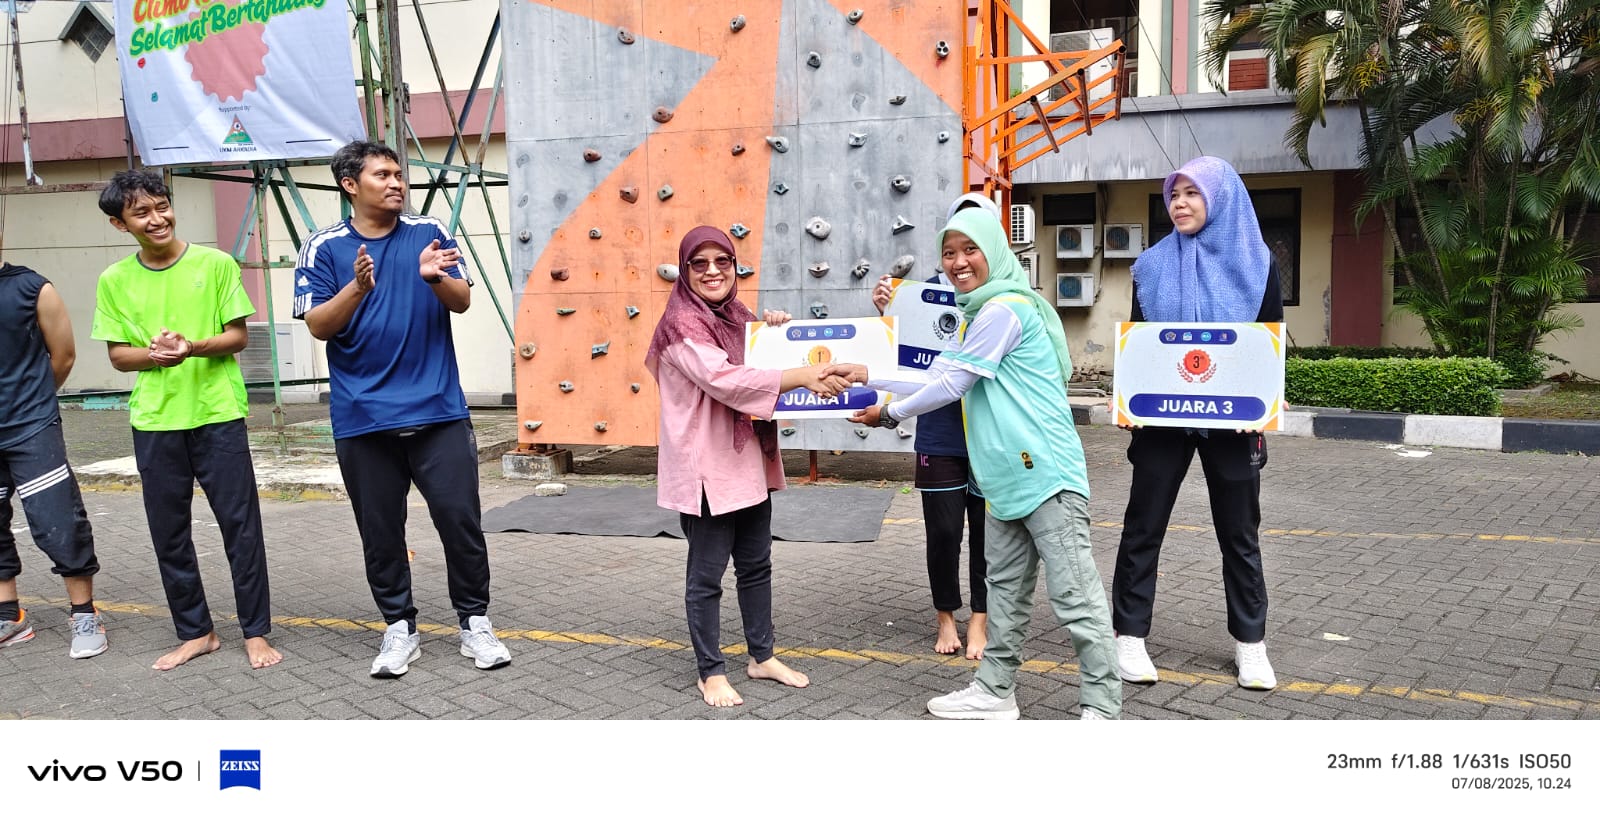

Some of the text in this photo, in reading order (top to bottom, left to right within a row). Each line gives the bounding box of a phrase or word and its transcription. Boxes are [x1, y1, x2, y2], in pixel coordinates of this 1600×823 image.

[129, 10, 209, 56] Selamat
[842, 391, 850, 404] 1
[1158, 399, 1234, 415] JUARA 3
